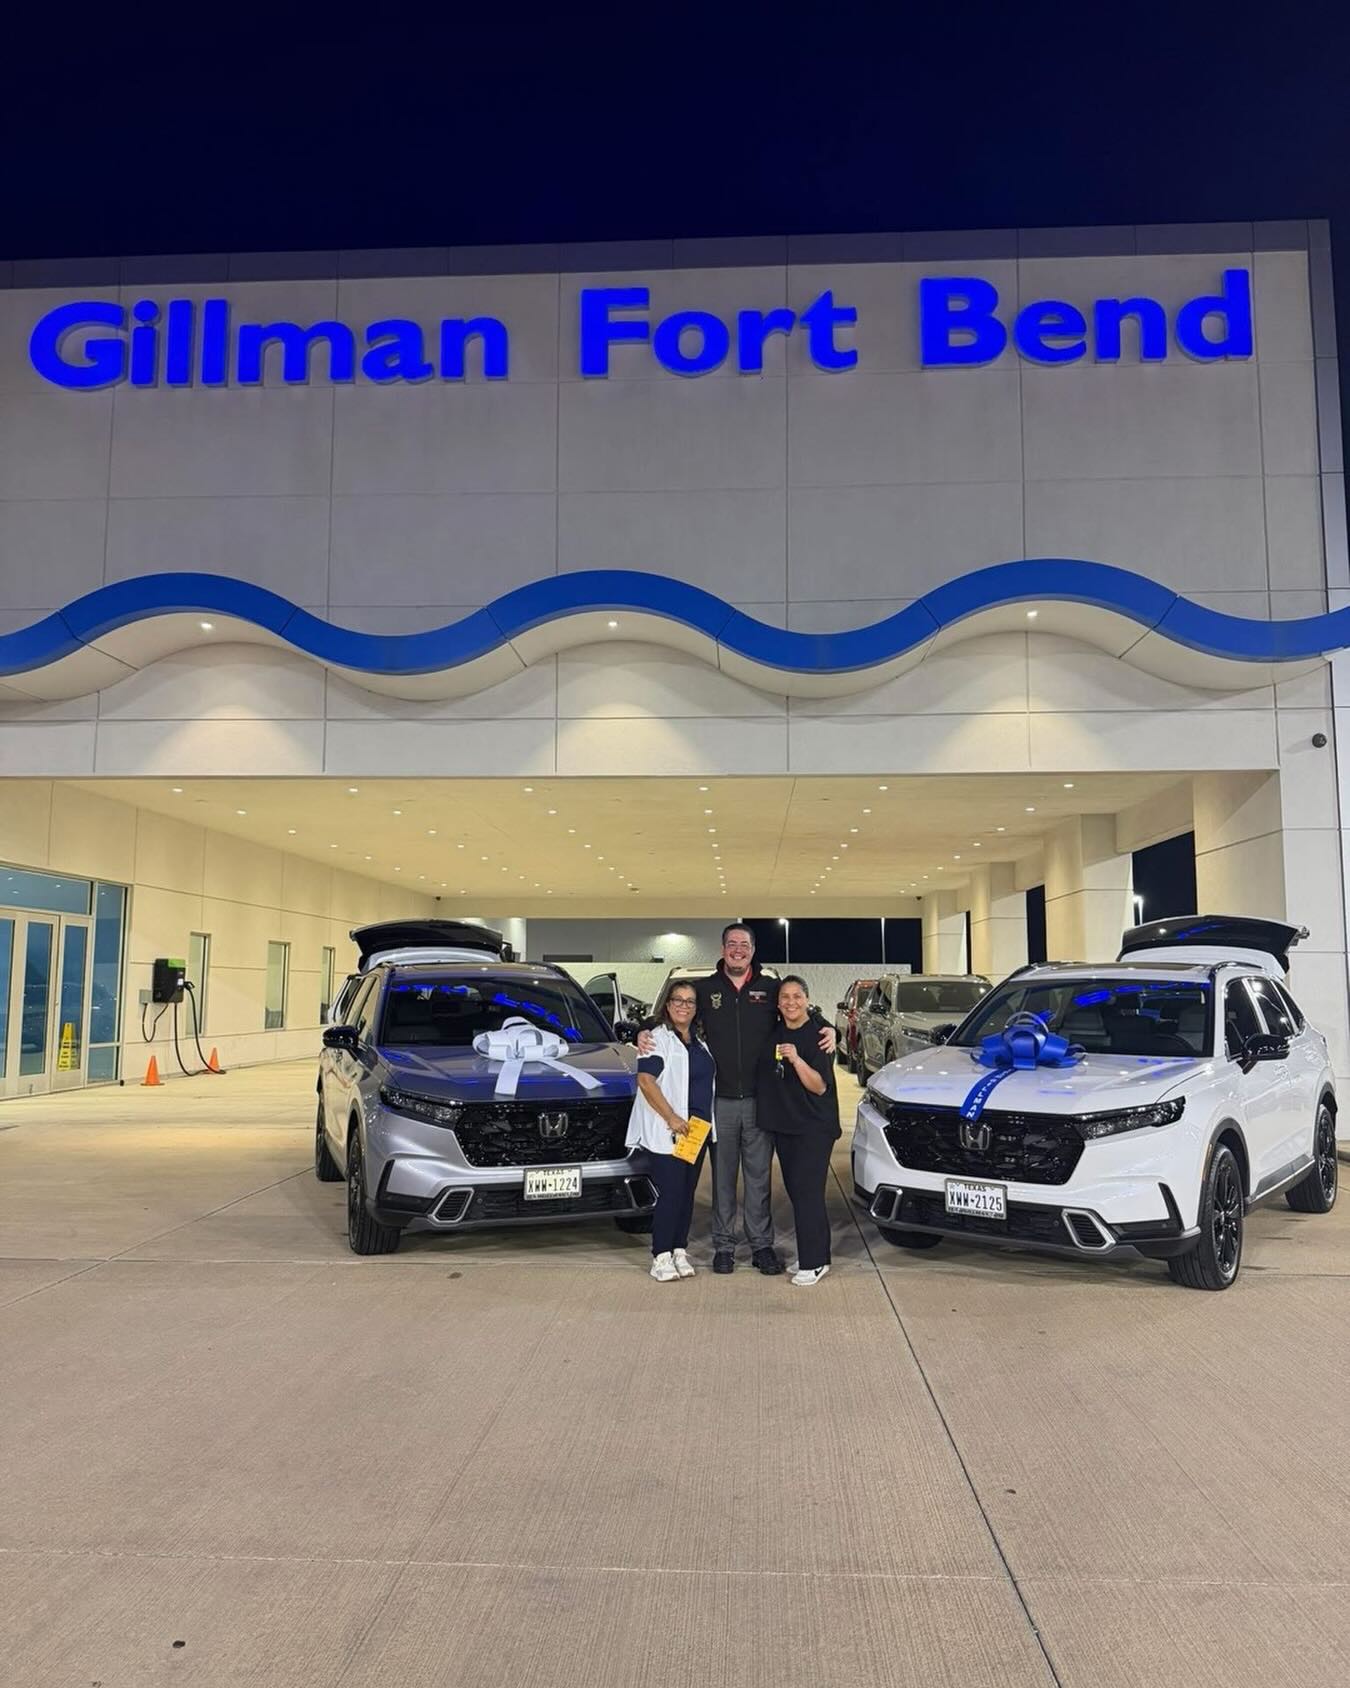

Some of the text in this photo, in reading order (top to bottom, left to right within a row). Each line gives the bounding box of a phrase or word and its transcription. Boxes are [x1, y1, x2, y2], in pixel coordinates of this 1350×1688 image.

[29, 267, 1256, 390] Gillman Fort Bend
[964, 1183, 987, 1192] TEXAS
